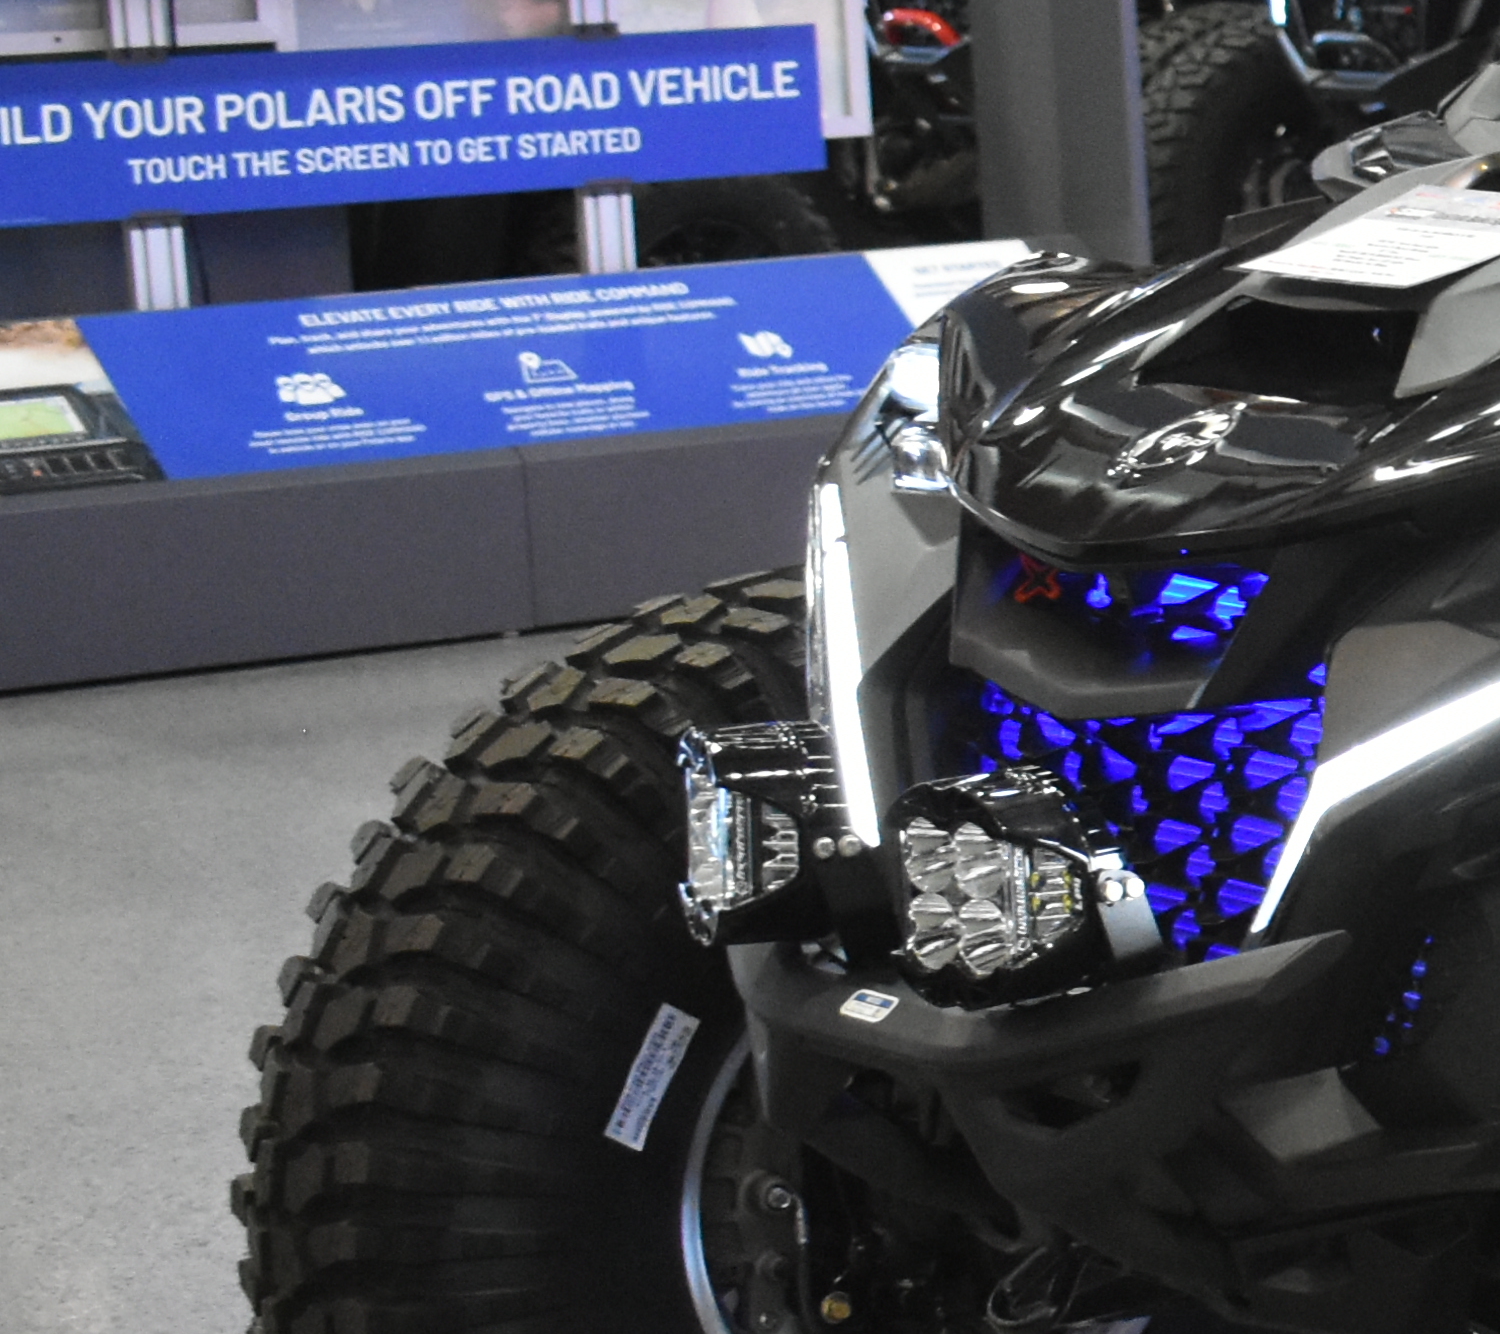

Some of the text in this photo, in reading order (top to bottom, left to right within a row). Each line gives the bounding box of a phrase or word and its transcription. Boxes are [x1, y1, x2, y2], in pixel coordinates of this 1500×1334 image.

[82, 96, 205, 140] YOUR
[216, 84, 404, 133] POLARIS
[414, 78, 496, 120] OFF
[506, 71, 620, 115] ROAD
[627, 60, 801, 107] VEHICLE
[127, 127, 641, 185] TOUCH THE SCREEN TO GET STARTED
[298, 308, 388, 327] ELEVATE
[388, 302, 450, 318] EVERY
[499, 293, 549, 309] WITH
